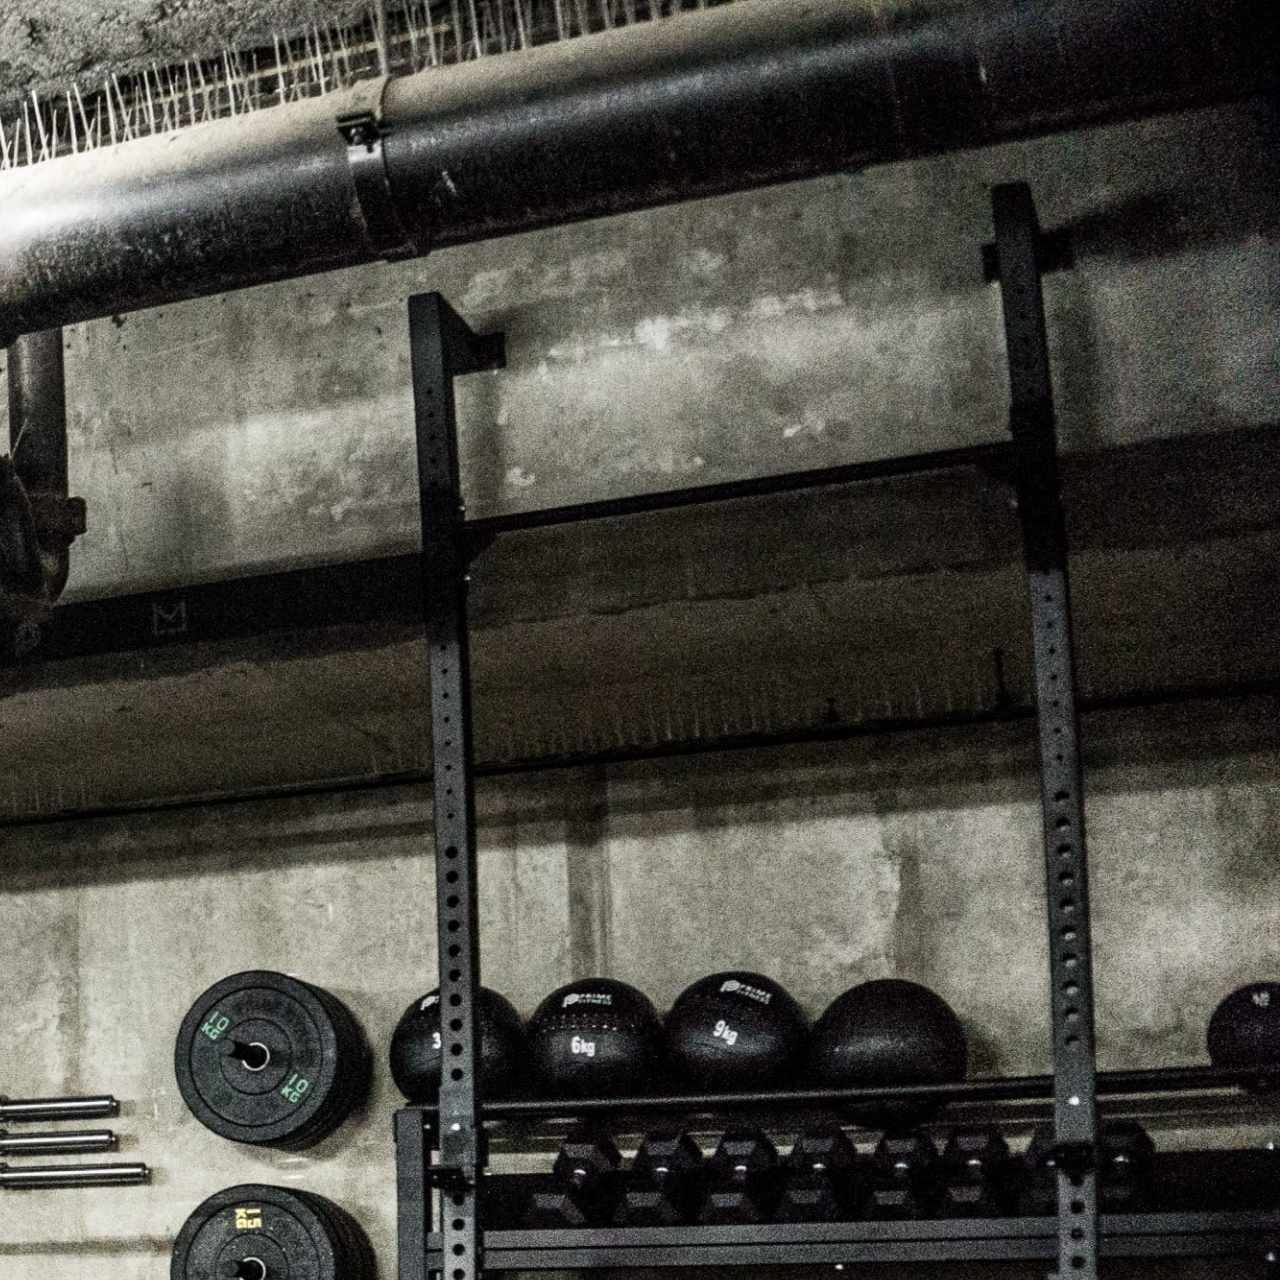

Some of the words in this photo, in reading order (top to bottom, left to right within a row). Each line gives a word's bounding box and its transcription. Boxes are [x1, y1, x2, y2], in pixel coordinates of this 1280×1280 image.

[201, 1022, 221, 1040] KG
[209, 1010, 230, 1032] 10
[712, 1019, 739, 1046] 9kg
[570, 1035, 596, 1058] 6kg
[280, 1085, 301, 1104] KG
[288, 1073, 310, 1094] 10
[234, 1207, 247, 1229] KG
[246, 1207, 262, 1229] 15
